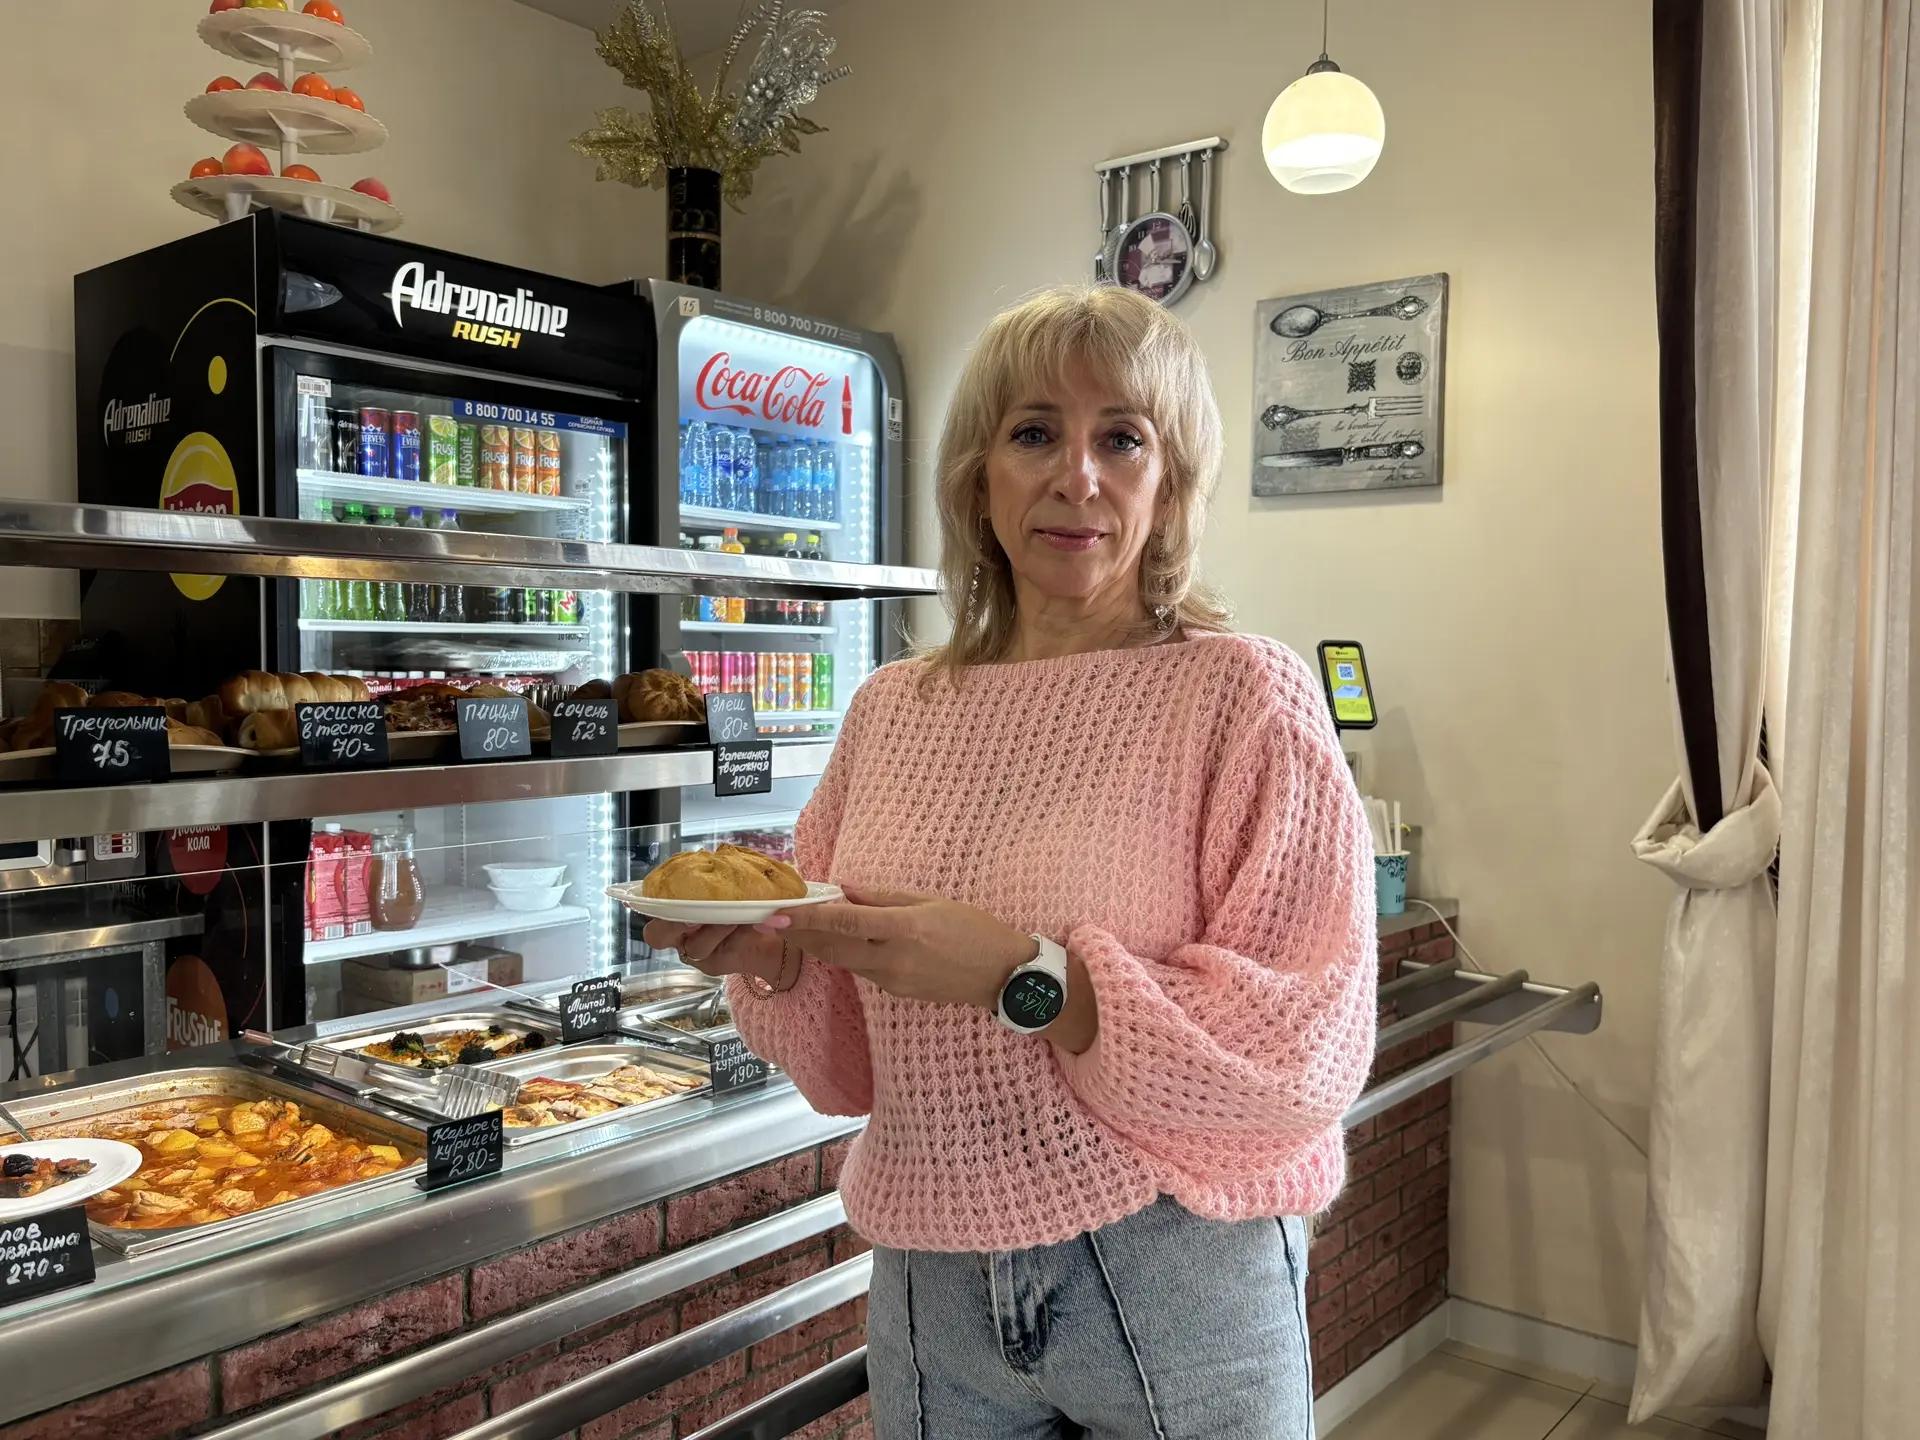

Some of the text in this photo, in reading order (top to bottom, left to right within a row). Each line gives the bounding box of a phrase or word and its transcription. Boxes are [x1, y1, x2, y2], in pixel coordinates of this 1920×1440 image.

[391, 261, 569, 338] Adrenaline
[682, 300, 696, 313] 15
[452, 320, 522, 349] RUSH
[753, 307, 762, 321] 8
[764, 310, 787, 326] 800
[789, 316, 812, 332] 700
[813, 321, 840, 339] 7777
[1281, 338, 1326, 363] Bon
[103, 392, 171, 448] Adrenaline
[465, 402, 556, 426] 8 800 700 14 55
[125, 427, 151, 444] RUSH
[60, 714, 168, 741] Треугольник
[315, 721, 376, 737] тесте
[717, 745, 769, 763] Запеканка
[717, 759, 770, 777] творожная
[187, 835, 210, 852] кола
[567, 993, 606, 1014] Минтай
[715, 1051, 757, 1073] курина
[0, 1222, 41, 1245] лов
[0, 1232, 81, 1261] овядина
